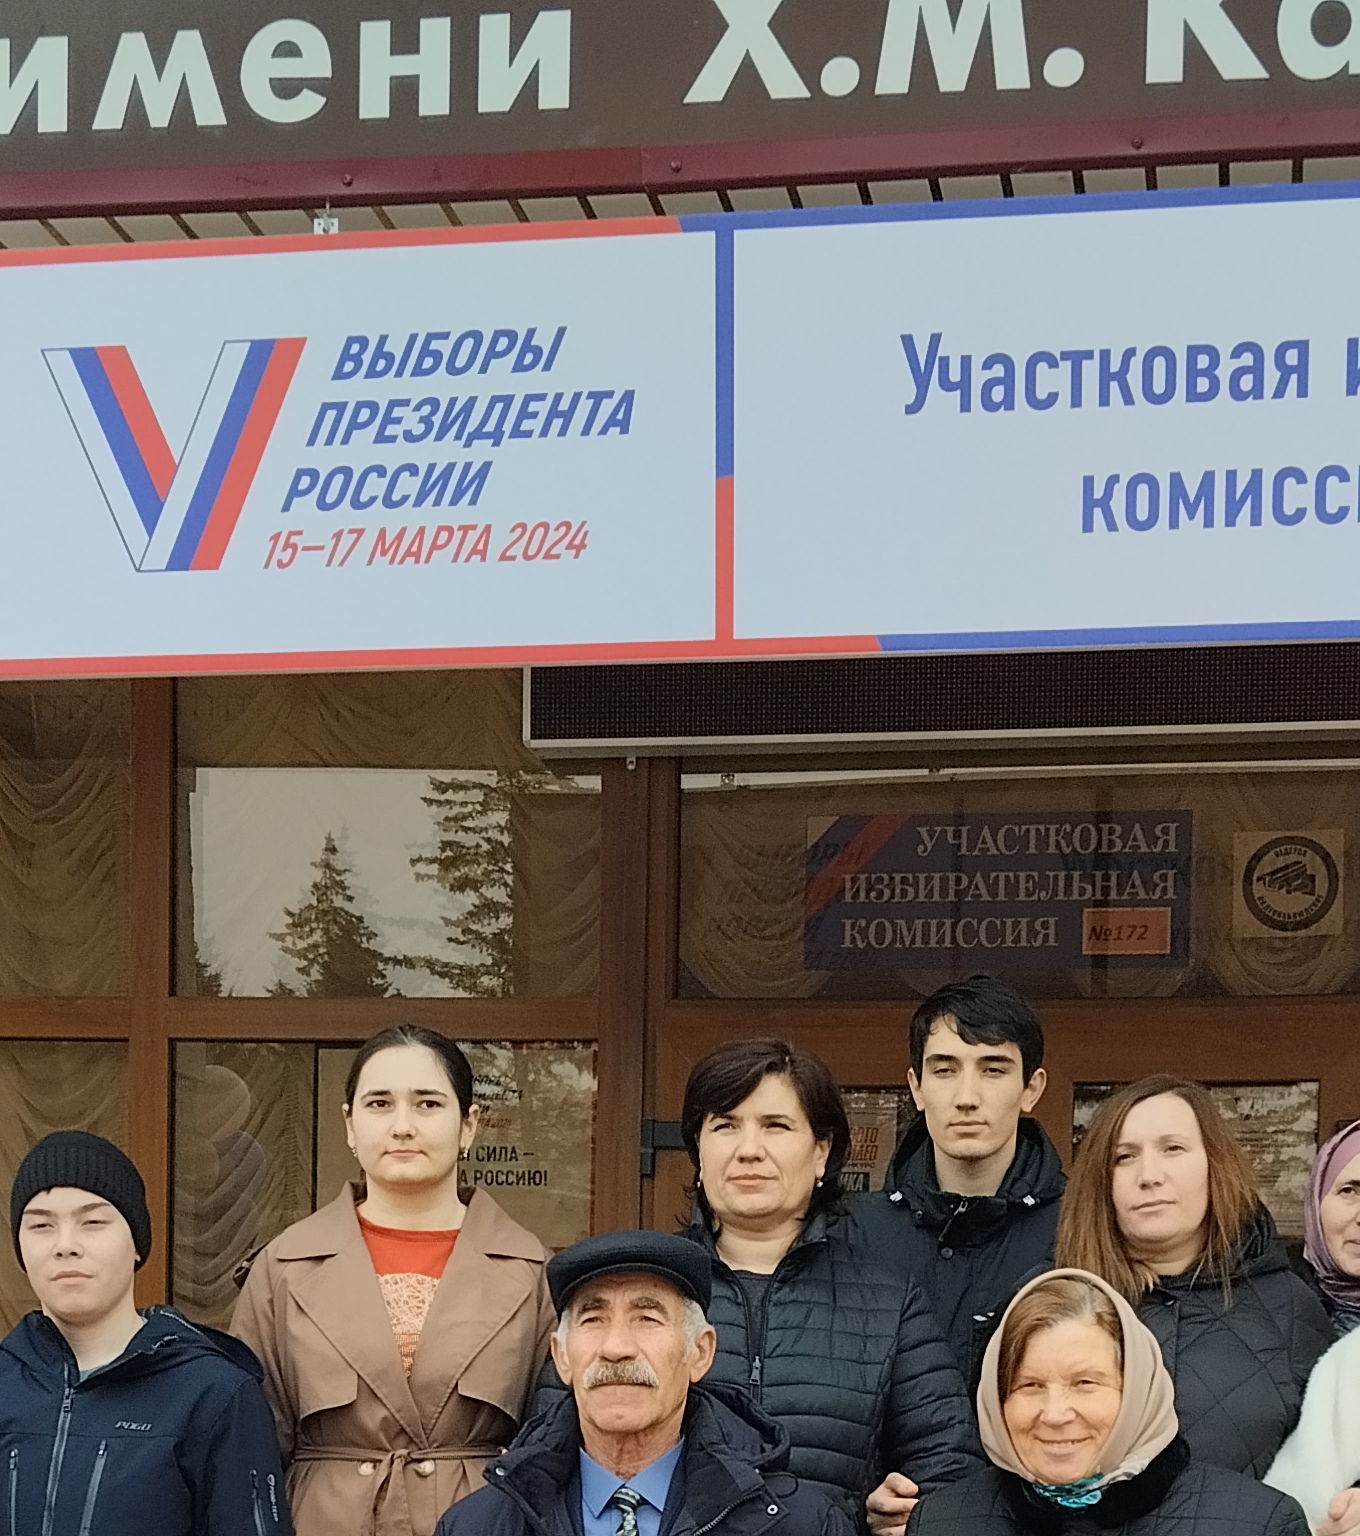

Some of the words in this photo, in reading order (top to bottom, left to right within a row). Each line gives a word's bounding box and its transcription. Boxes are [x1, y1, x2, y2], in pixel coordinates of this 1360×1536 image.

[331, 326, 567, 381] ВЫБОРЫ
[901, 331, 1311, 415] Участковая
[306, 389, 635, 449] ПРЕЗИДЕНТА
[281, 460, 493, 513] РОССИИ
[263, 527, 367, 571] 15–17
[368, 523, 492, 566] МАРТА
[498, 520, 589, 562] 2024
[916, 822, 1180, 858] УЧАСТКОВАЯ
[841, 869, 1178, 903] ИЗБИРАТЕЛЬНАЯ
[841, 917, 1058, 949] КОМИССИЯ
[475, 1145, 519, 1163] СИЛА
[473, 1169, 548, 1187] РОССИЮ!
